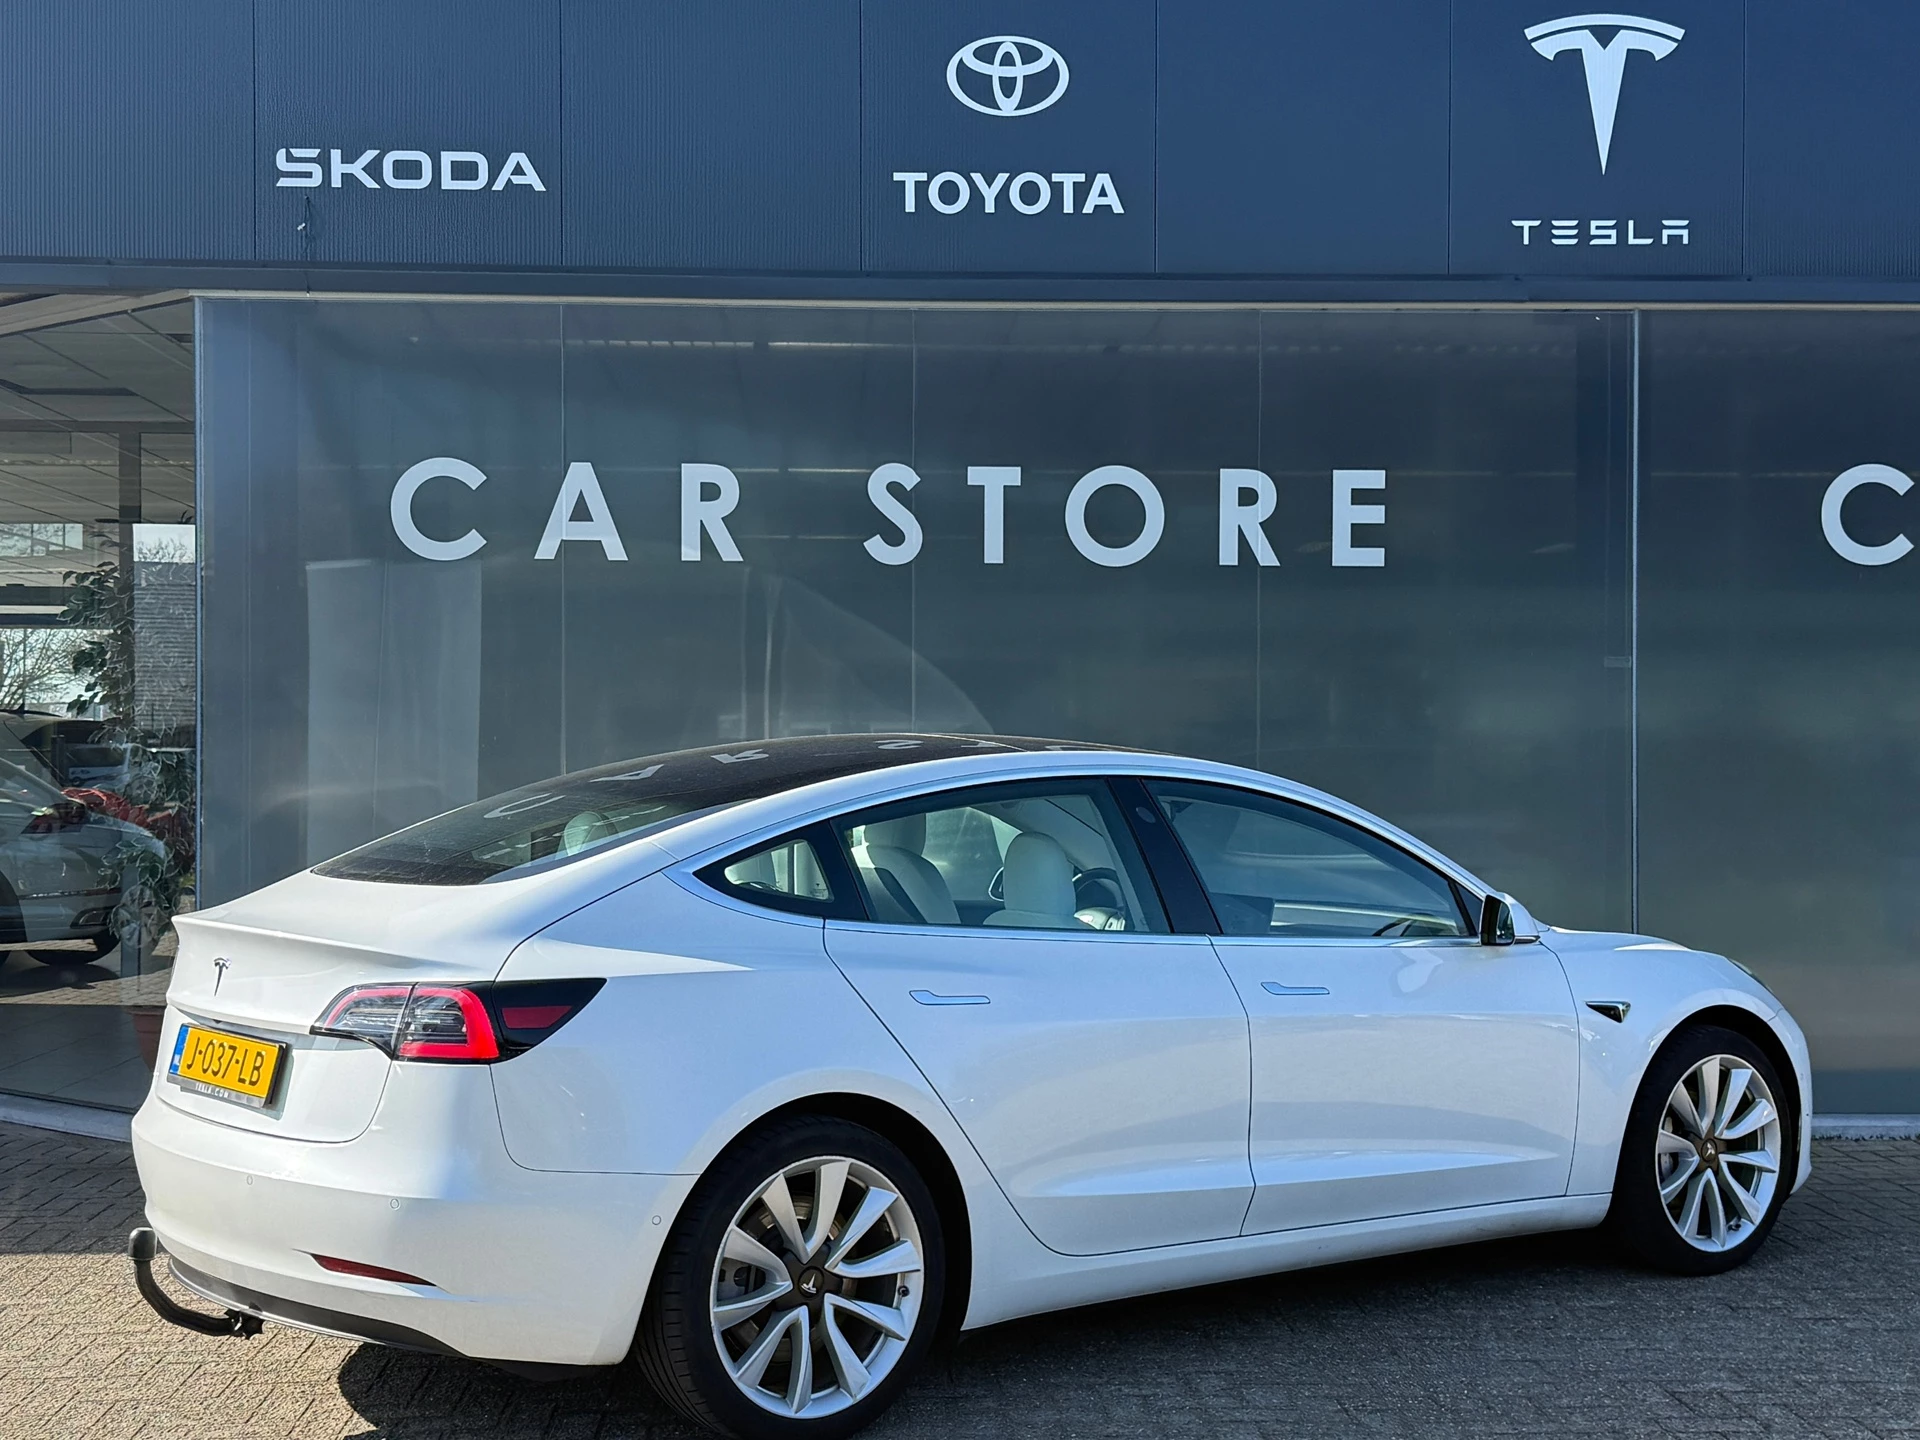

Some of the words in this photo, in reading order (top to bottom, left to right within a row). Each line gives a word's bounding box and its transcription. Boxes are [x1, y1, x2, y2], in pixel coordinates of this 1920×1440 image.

[892, 171, 1125, 215] TOYOTA
[1510, 219, 1690, 245] TESLA
[390, 457, 744, 562] CAR
[863, 462, 1386, 567] STORE
[1821, 463, 1916, 566] C
[186, 1036, 266, 1087] J-037-LB
